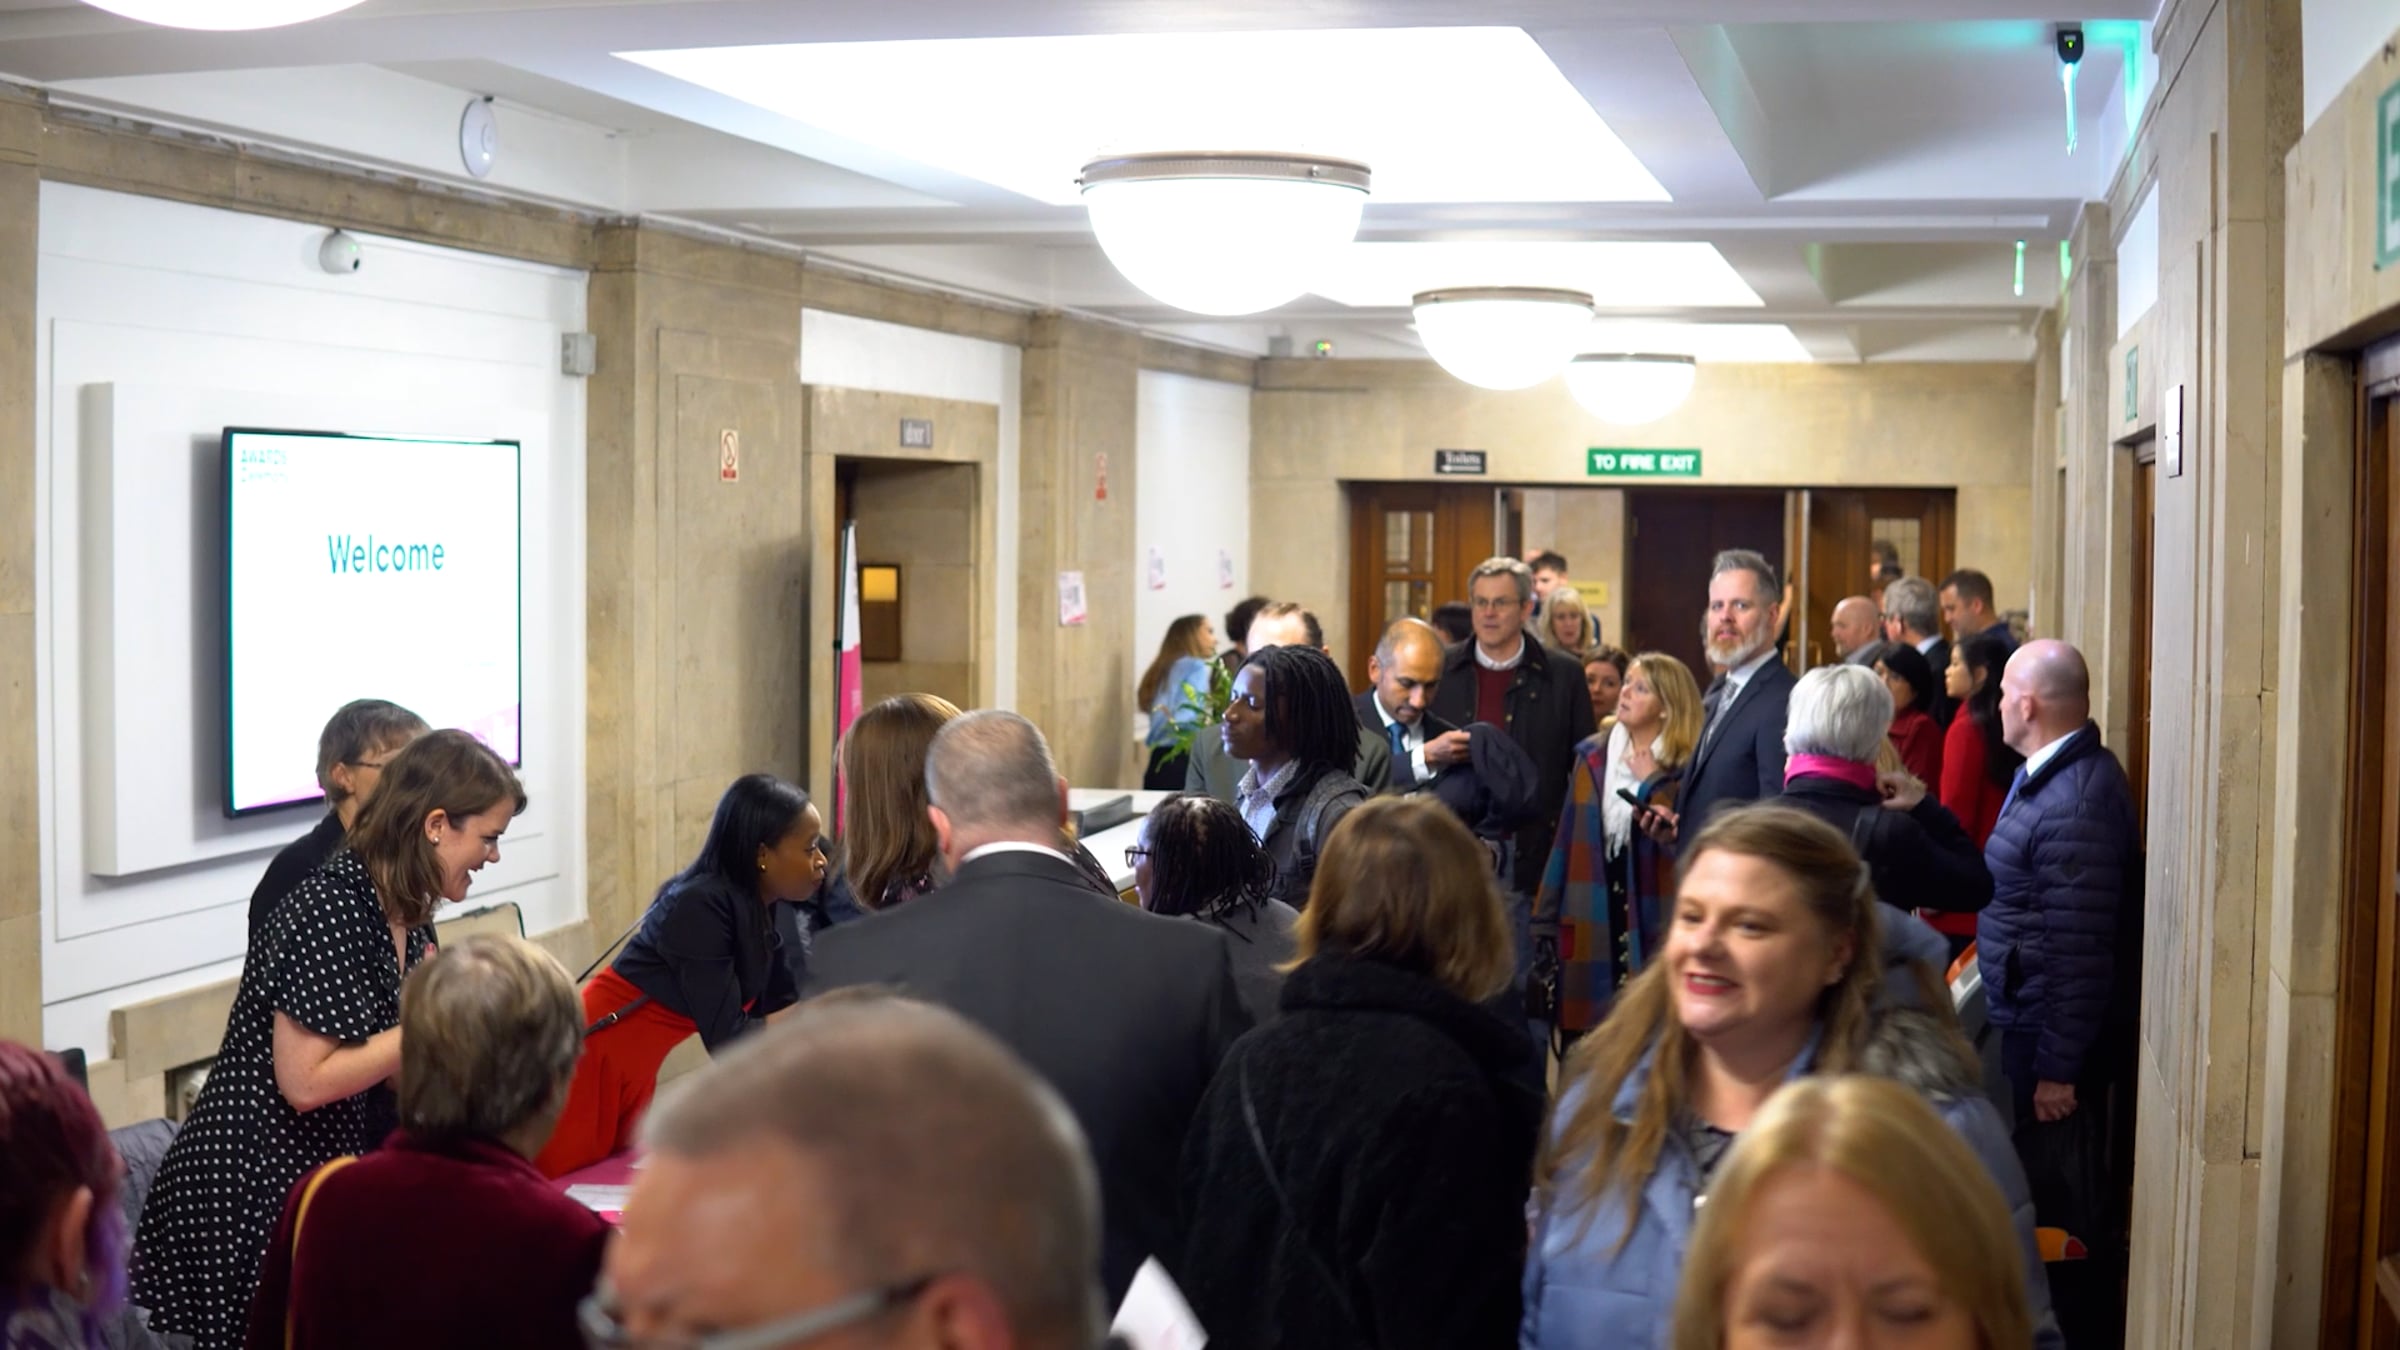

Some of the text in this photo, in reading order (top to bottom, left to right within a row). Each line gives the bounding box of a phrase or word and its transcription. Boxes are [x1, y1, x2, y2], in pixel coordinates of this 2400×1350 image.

[1593, 453, 1696, 471] TO FIRE EXIT
[328, 534, 445, 574] Welcome
